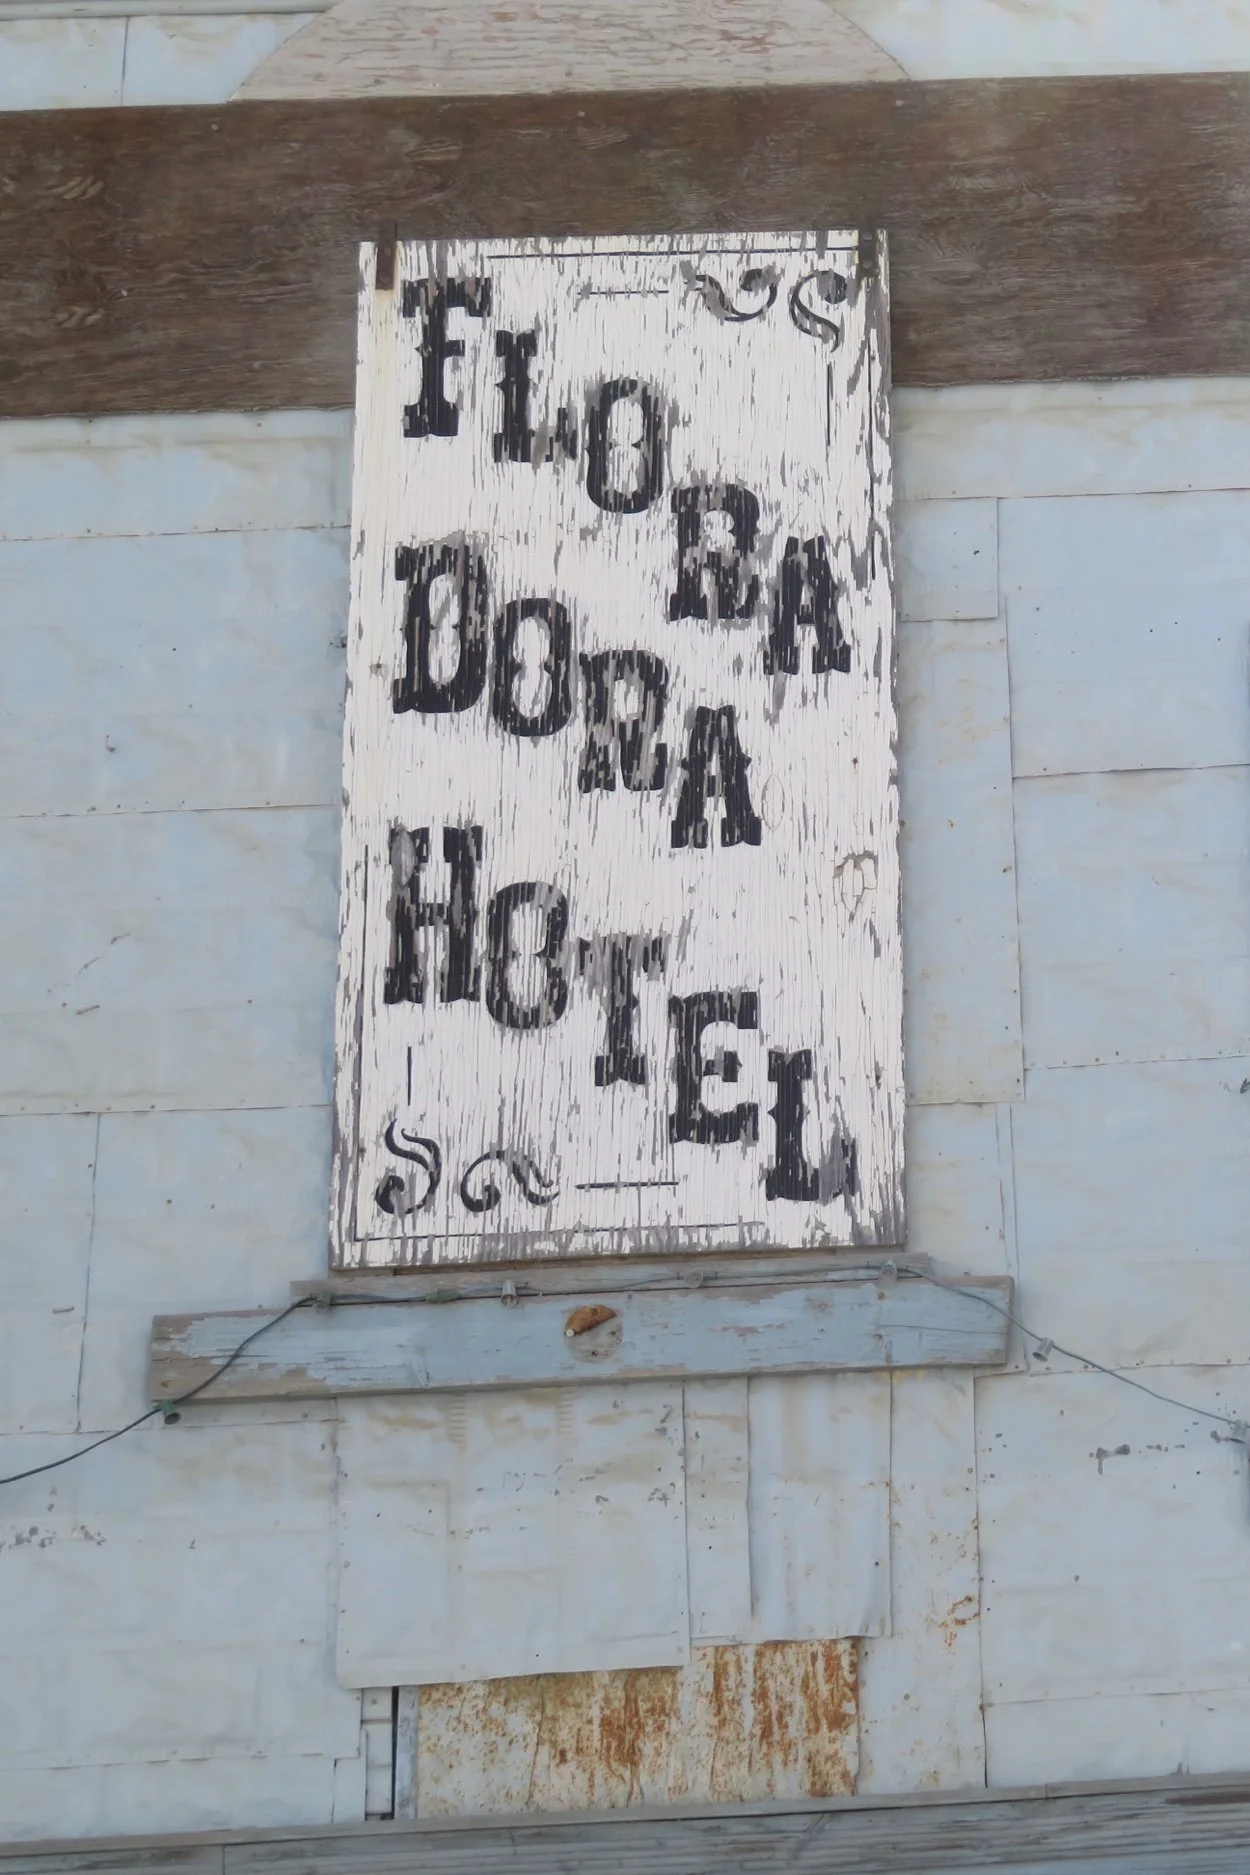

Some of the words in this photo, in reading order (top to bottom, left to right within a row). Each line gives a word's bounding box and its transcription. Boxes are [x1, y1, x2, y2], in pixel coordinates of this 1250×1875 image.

[402, 276, 851, 674] FLORA
[393, 541, 762, 848] DORA
[384, 825, 856, 1202] HOTEL
